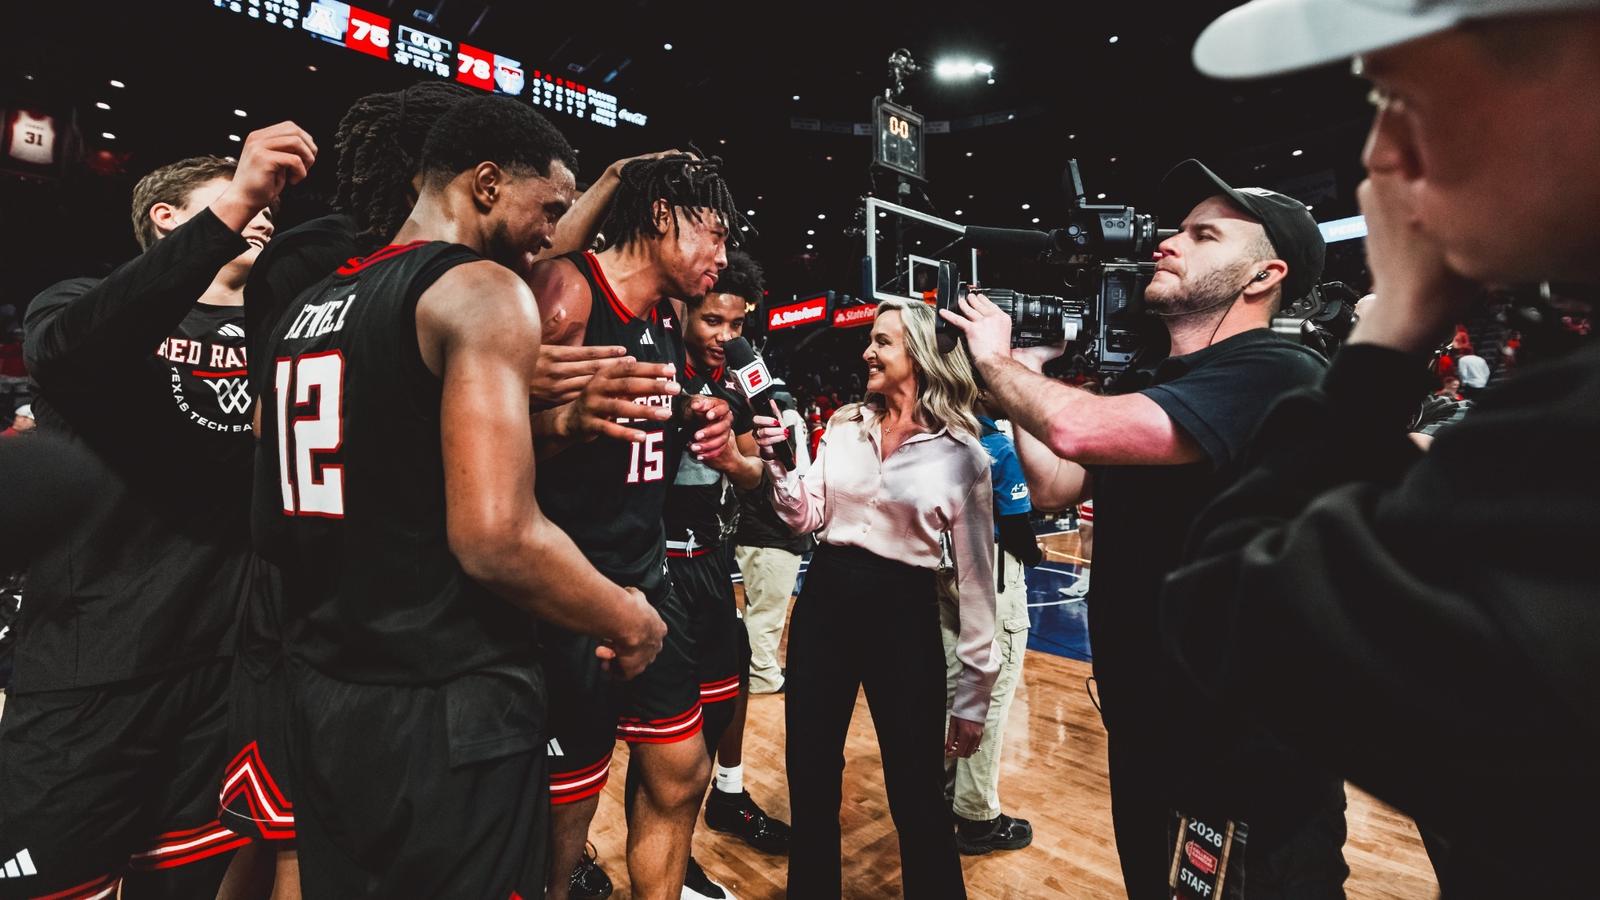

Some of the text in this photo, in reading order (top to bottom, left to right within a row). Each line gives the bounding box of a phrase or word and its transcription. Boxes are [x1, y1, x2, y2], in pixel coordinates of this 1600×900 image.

[351, 19, 390, 48] 75
[411, 32, 441, 53] 0.0
[458, 54, 491, 80] 78
[587, 88, 617, 104] PLAYER
[588, 97, 617, 112] POINTS
[591, 113, 617, 128] FOULS
[25, 132, 43, 147] 31
[170, 366, 255, 433] TEXAS TECH BA
[275, 349, 344, 519] 12
[627, 431, 664, 484] 15
[1188, 817, 1223, 848] 2026
[1180, 867, 1212, 897] STAFF
